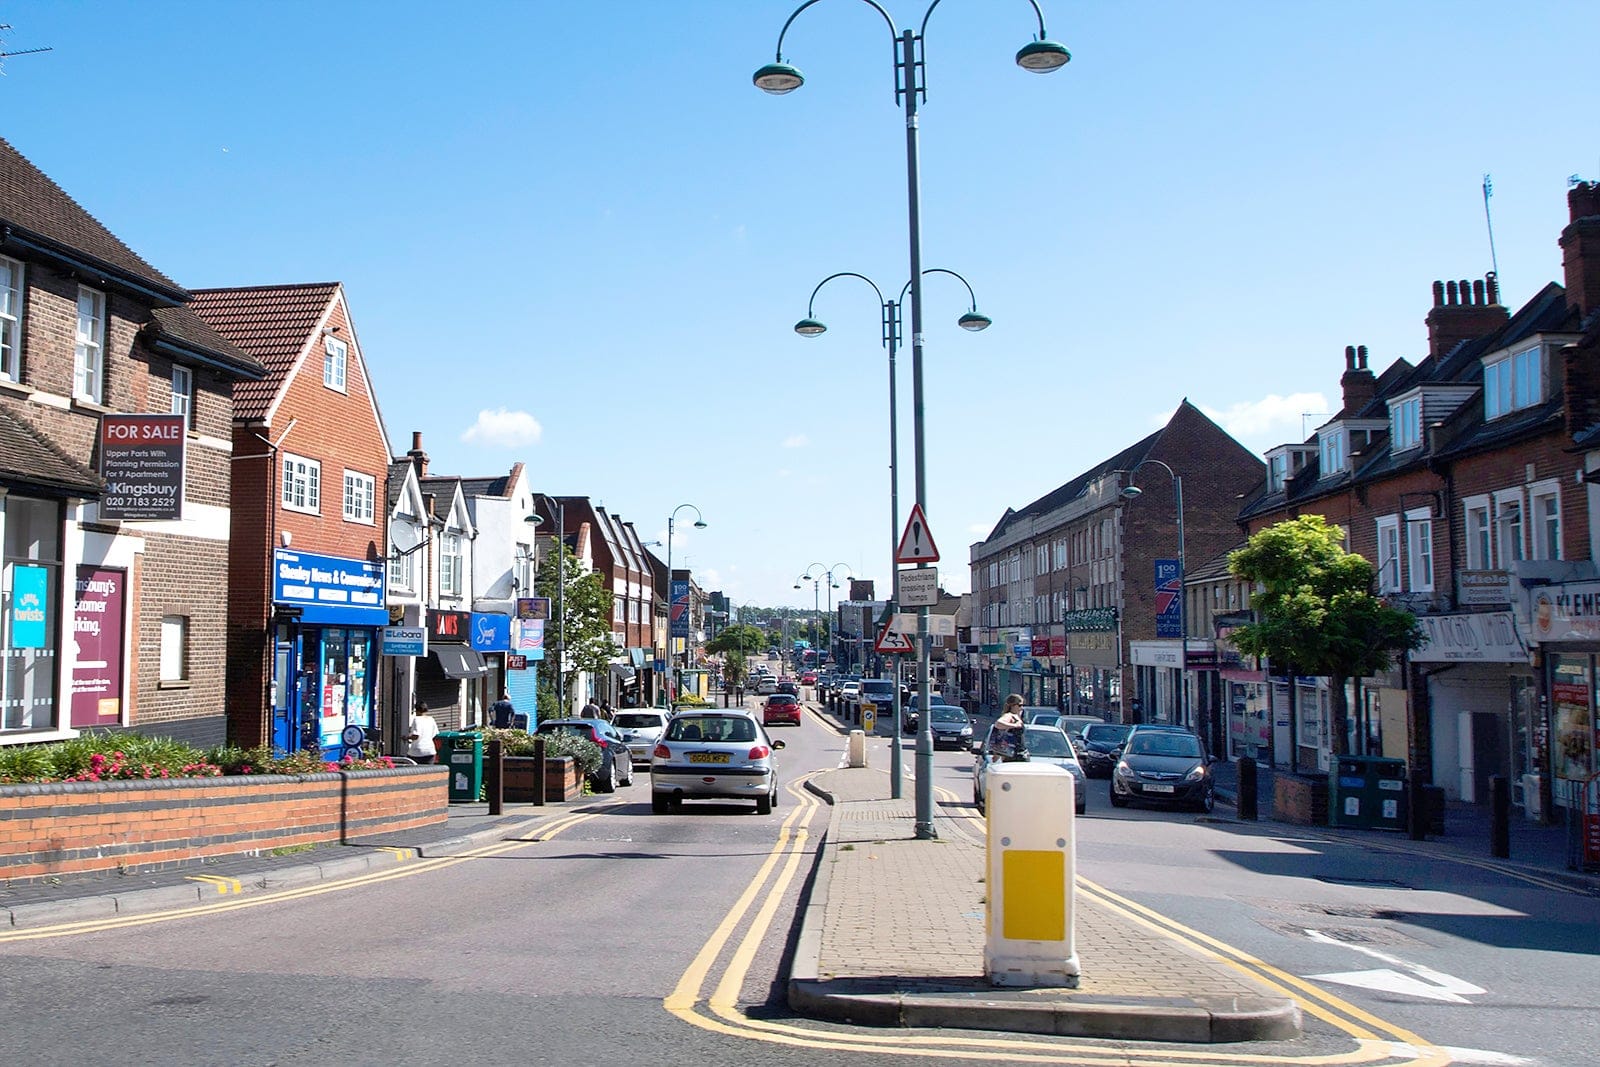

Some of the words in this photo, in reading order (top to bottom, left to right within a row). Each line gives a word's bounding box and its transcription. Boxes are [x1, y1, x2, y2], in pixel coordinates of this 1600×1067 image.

[107, 425, 138, 439] FOR
[142, 425, 179, 439] SALE
[106, 450, 129, 458] Upper
[106, 460, 138, 468] Planning
[113, 482, 177, 496] Kingsbury
[106, 497, 124, 506] 020
[127, 497, 149, 506] 7183
[151, 498, 175, 506] 2529
[311, 567, 332, 583] News
[333, 569, 340, 584] &
[900, 573, 935, 582] Pedestrians
[1462, 575, 1508, 584] Miele
[900, 584, 926, 593] crossing
[392, 630, 422, 638] Lebara
